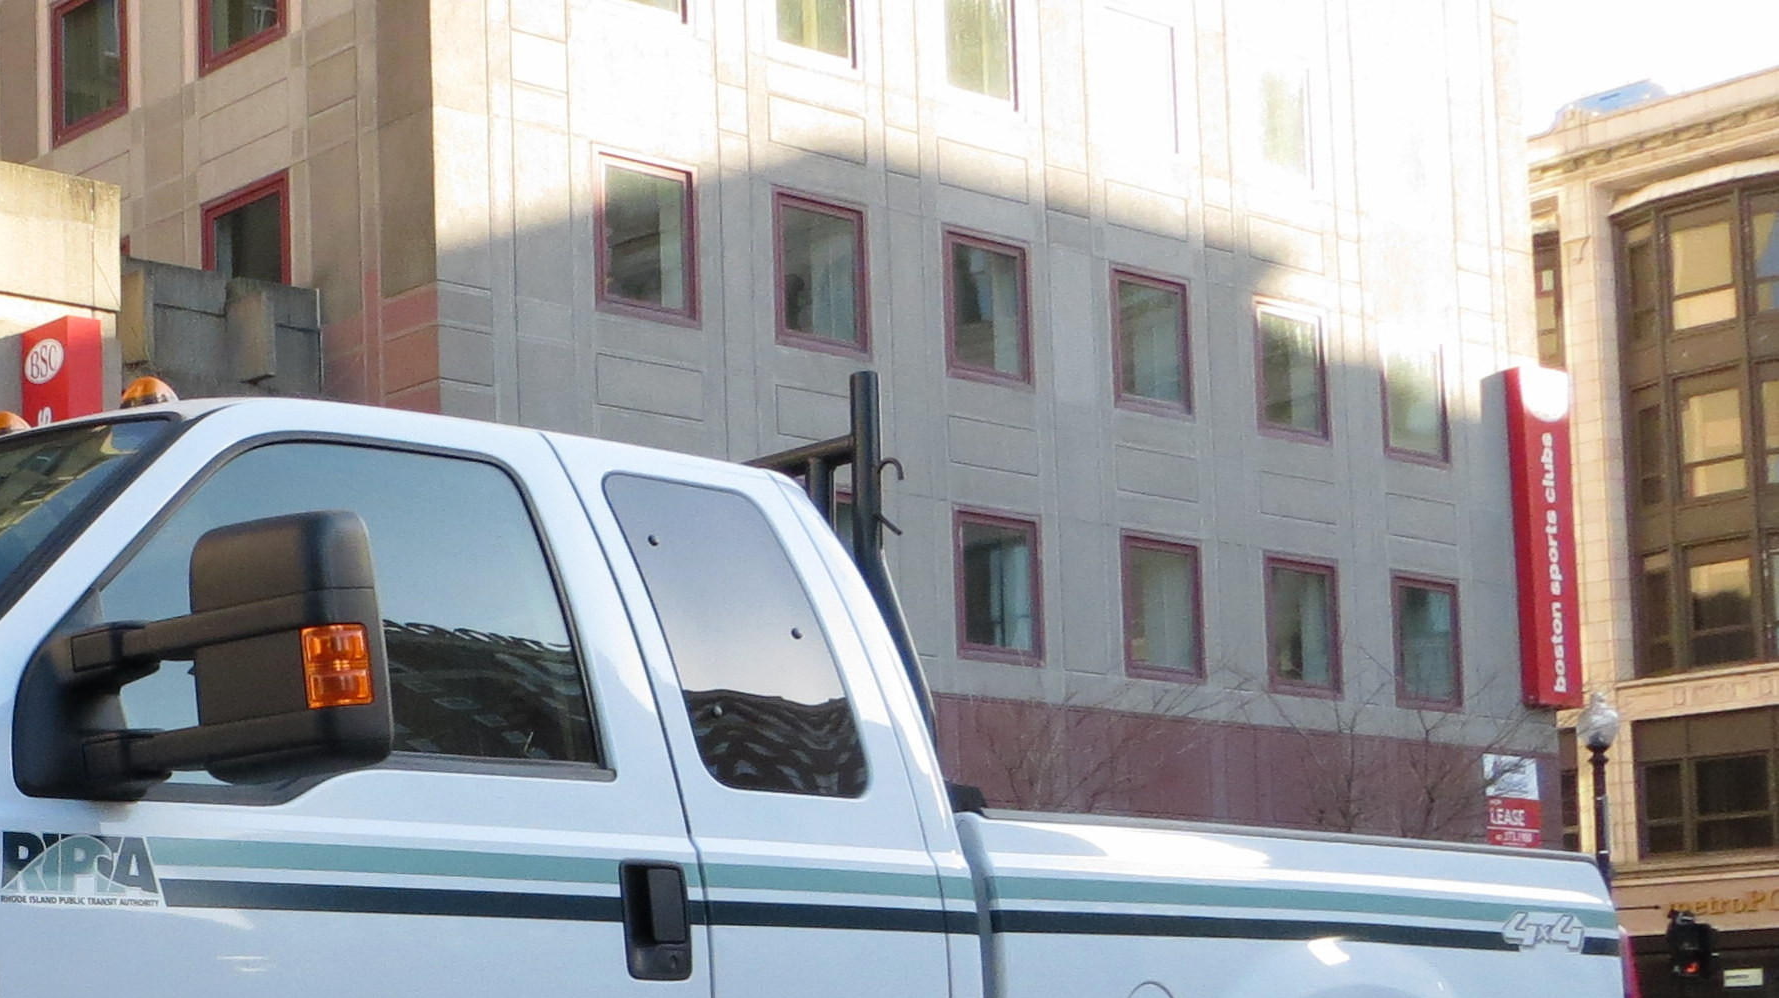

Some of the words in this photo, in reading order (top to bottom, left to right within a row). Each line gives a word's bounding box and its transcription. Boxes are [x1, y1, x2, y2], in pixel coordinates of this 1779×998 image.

[30, 344, 57, 379] BSC
[1541, 432, 1556, 503] clubs
[1546, 509, 1562, 596] sports
[1551, 601, 1567, 693] boston
[1489, 808, 1525, 826] LEASE
[1, 895, 27, 903] RHODE
[29, 896, 57, 904] ISLAND
[59, 897, 85, 905] PUBLIC
[119, 898, 159, 907] AUTHORITY
[1502, 911, 1585, 952] 4x4
